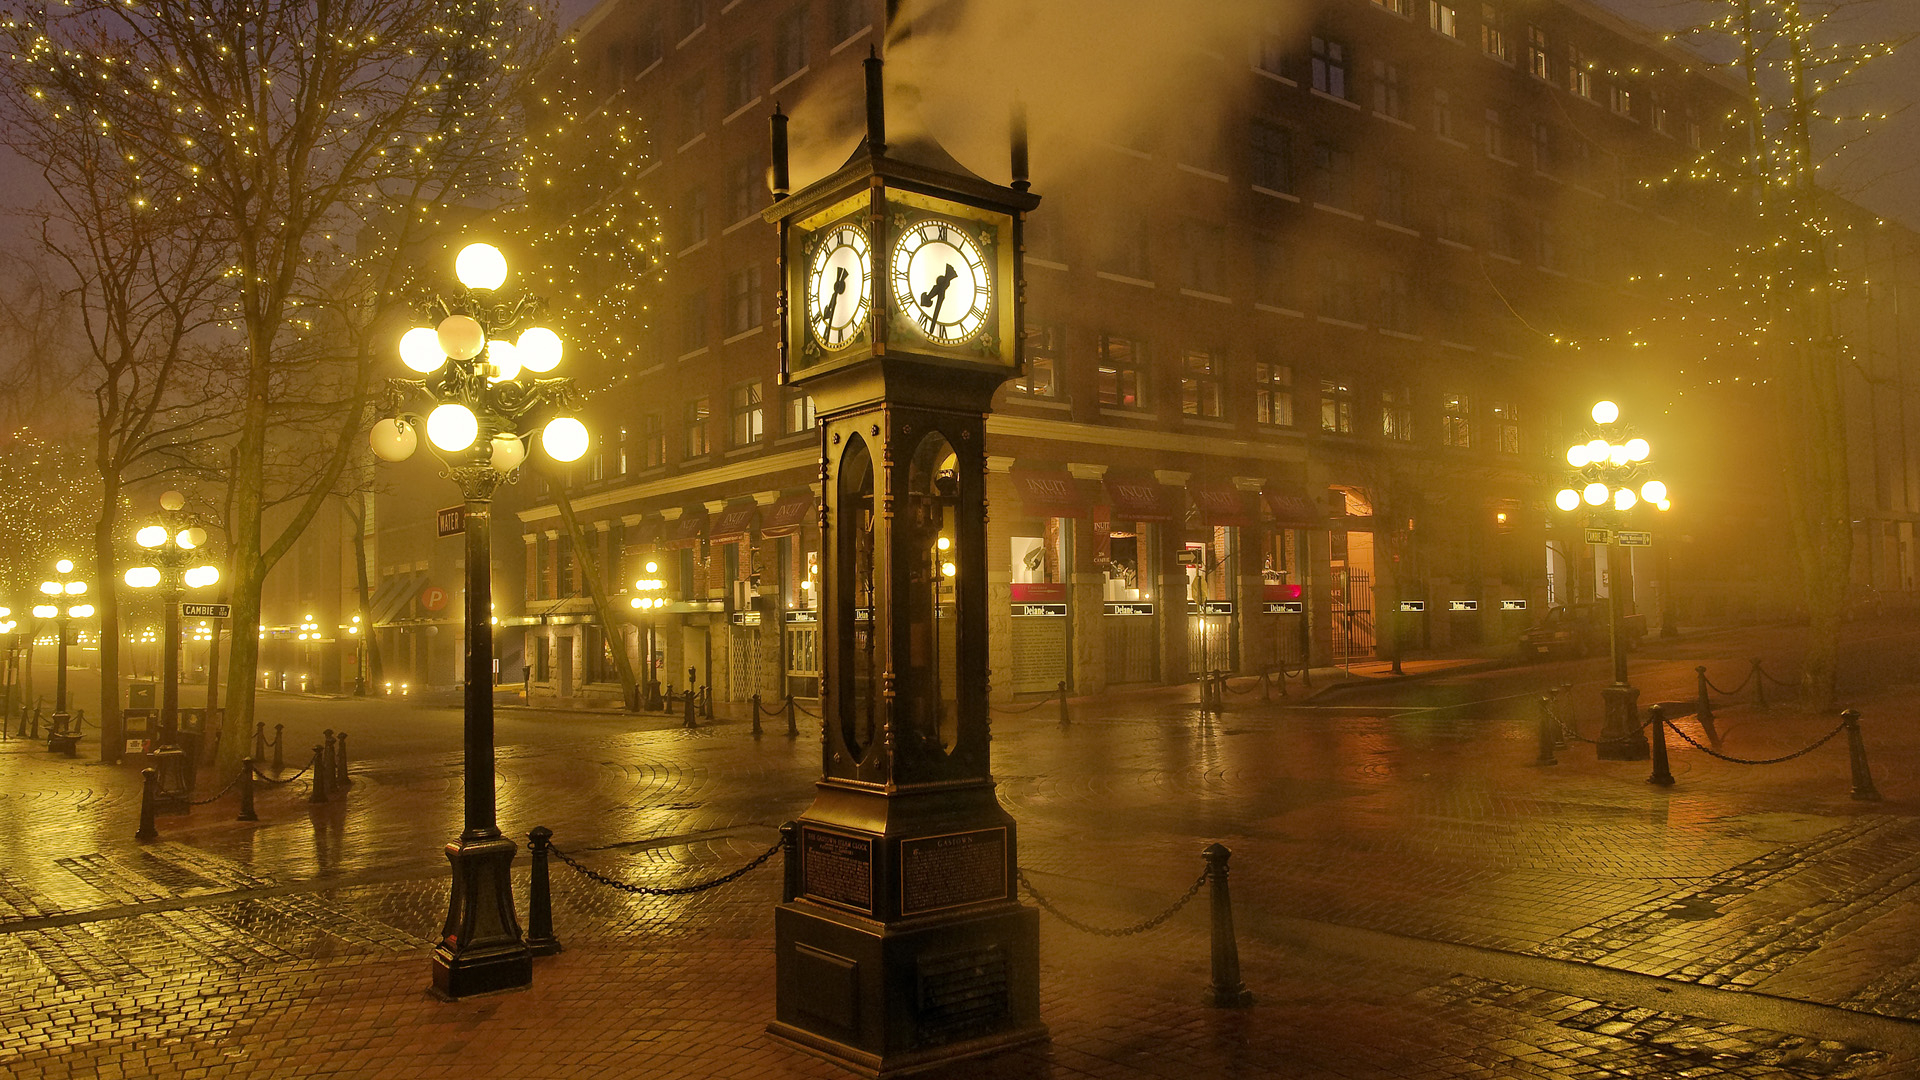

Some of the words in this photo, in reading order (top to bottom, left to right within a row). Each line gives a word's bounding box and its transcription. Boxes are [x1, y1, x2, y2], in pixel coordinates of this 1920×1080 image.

[917, 227, 929, 244] XI
[938, 226, 948, 242] XII
[959, 236, 967, 250] I
[900, 243, 914, 258] X
[971, 261, 983, 269] II
[895, 269, 909, 280] IX
[976, 286, 988, 295] III
[900, 292, 914, 311] VIII
[970, 305, 984, 321] IIII
[917, 313, 928, 331] VII
[939, 324, 948, 339] VI
[960, 323, 969, 336] V
[1026, 478, 1066, 492] INUIT
[1118, 485, 1154, 498] INUIT
[1200, 490, 1234, 506] INUIT
[1275, 495, 1305, 508] INUIT
[776, 502, 804, 516] INUIT
[440, 512, 459, 532] WATER
[723, 511, 748, 524] INUIT
[1094, 521, 1110, 530] INUIT
[428, 590, 443, 608] P
[185, 605, 215, 616] CAMBIE
[856, 610, 869, 619] Delan
[1024, 605, 1045, 615] Delané
[1115, 604, 1134, 615] Delané
[851, 842, 868, 852] CLOCK
[937, 836, 973, 848] GASTOWN
